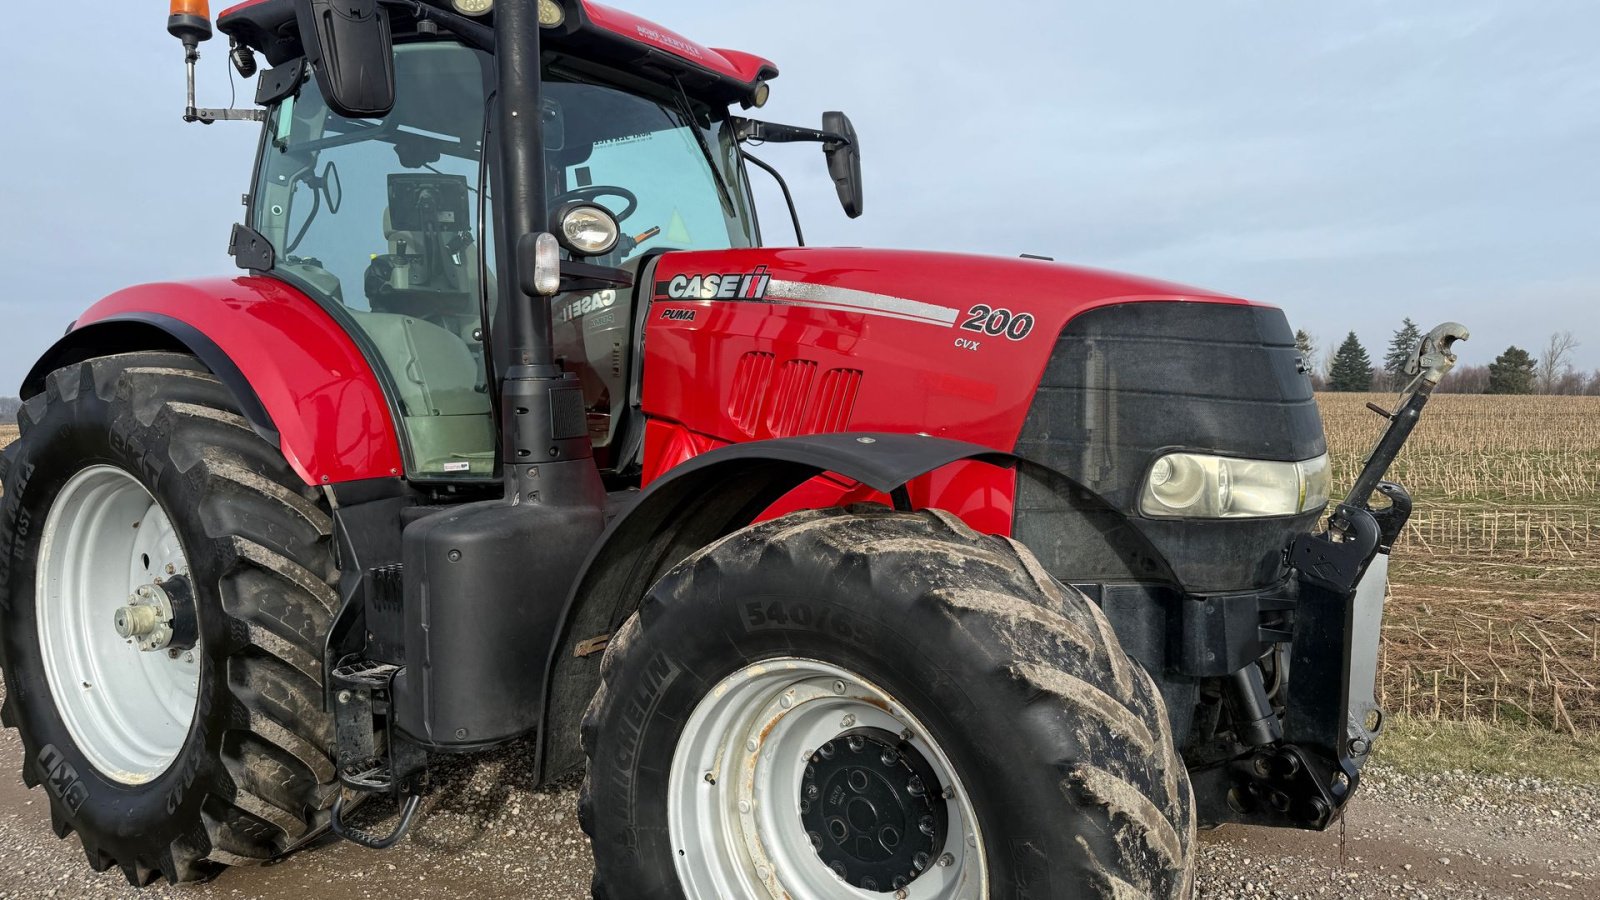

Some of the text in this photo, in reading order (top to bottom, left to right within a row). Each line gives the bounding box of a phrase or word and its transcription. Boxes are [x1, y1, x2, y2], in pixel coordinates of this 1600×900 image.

[661, 309, 696, 320] PUMA
[960, 303, 1035, 341] 200
[954, 338, 980, 351] CVX
[17, 506, 32, 536] 657
[610, 651, 681, 826] MICHELIN
[38, 745, 88, 816] BKT
